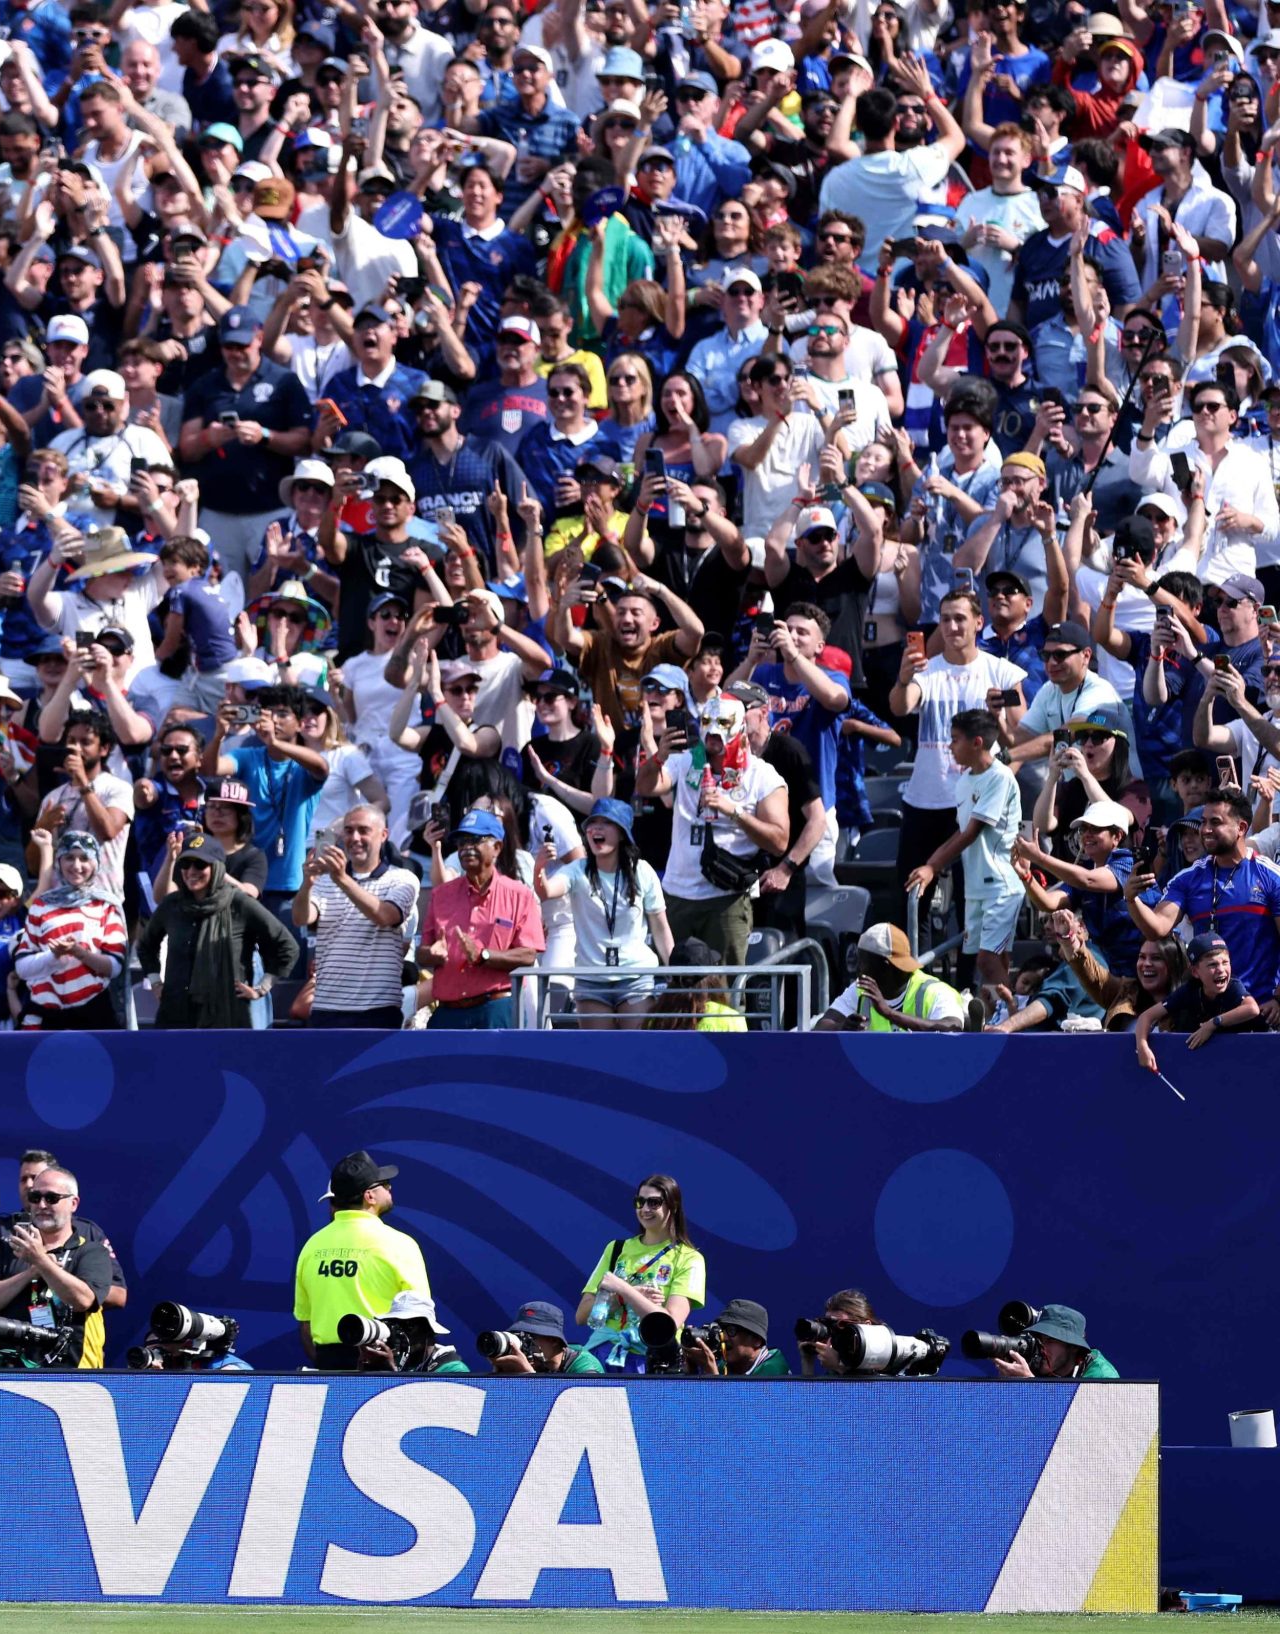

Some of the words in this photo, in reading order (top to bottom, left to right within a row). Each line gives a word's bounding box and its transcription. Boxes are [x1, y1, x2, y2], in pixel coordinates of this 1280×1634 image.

[997, 412, 1022, 437] 10
[30, 550, 43, 574] 7
[221, 782, 248, 801] RUN
[314, 1247, 370, 1259] SECURITY
[318, 1259, 358, 1278] 460
